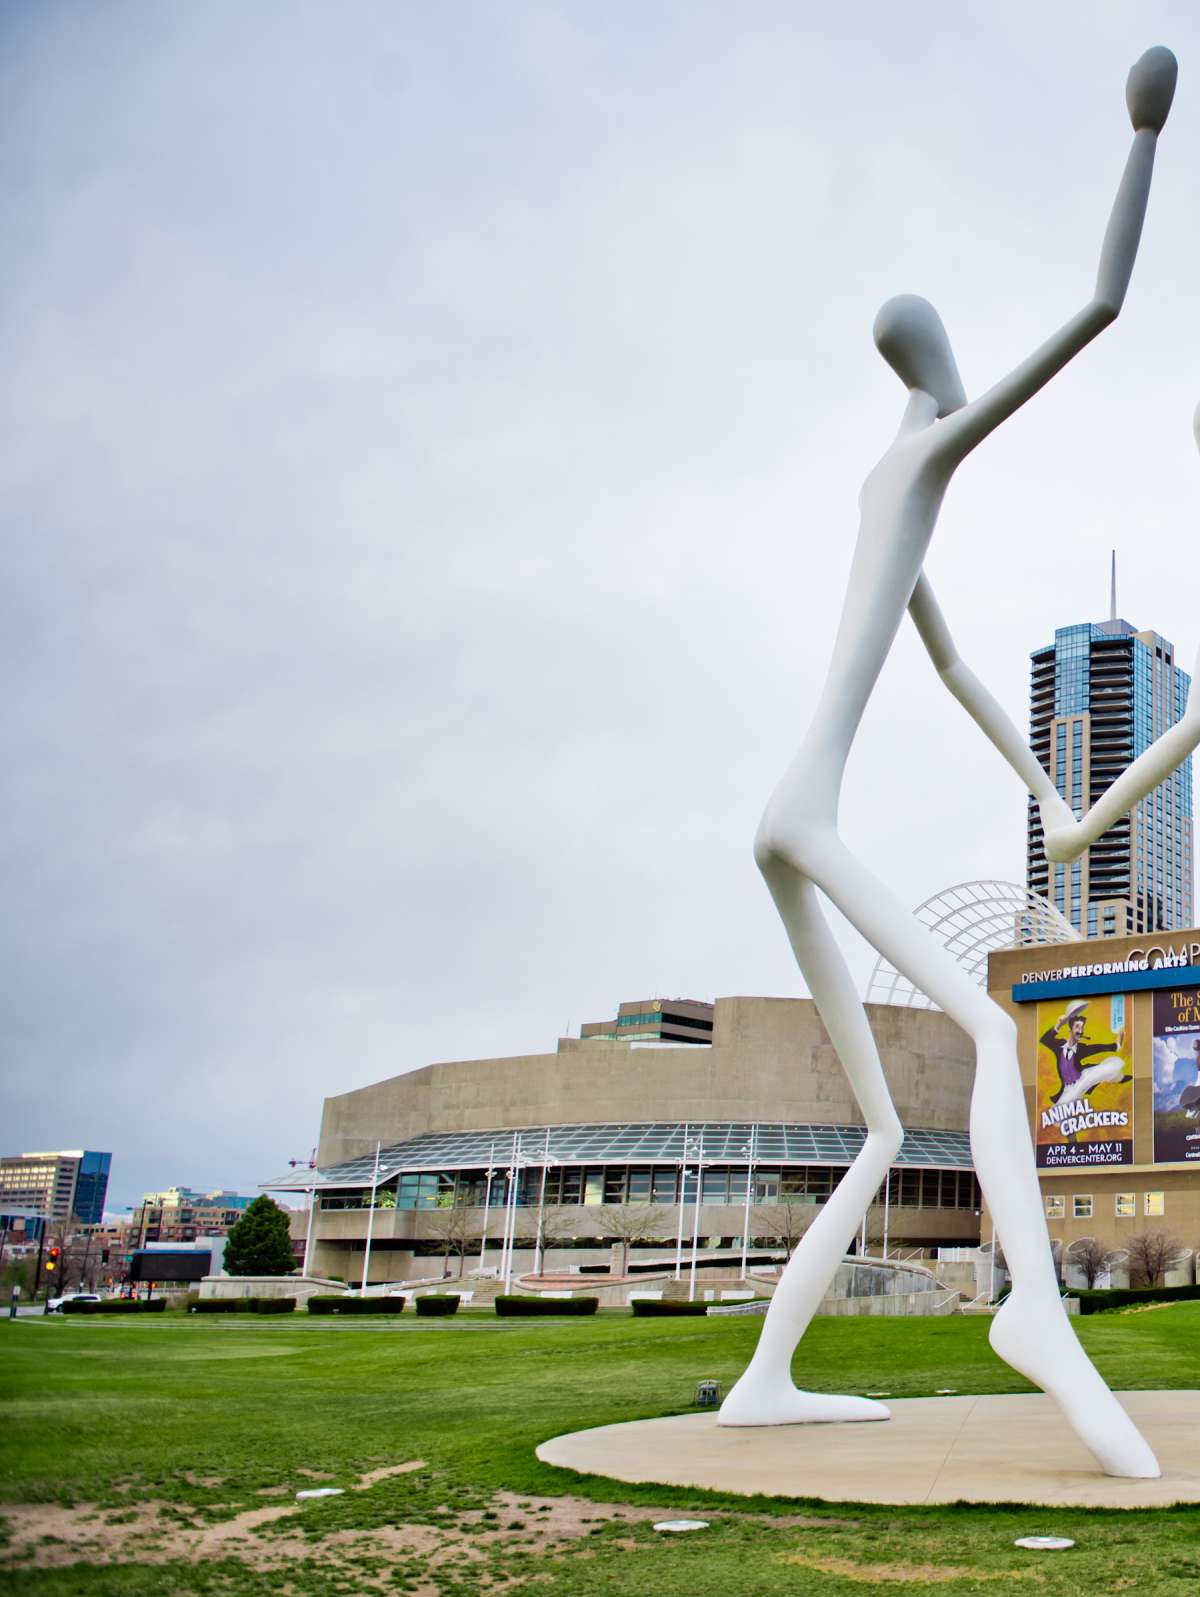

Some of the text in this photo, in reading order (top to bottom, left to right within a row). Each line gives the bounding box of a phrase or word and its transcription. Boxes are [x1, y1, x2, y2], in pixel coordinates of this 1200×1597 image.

[1021, 955, 1188, 984] DENVER PERFORMING ARTS
[1171, 992, 1194, 1008] The
[1178, 1009, 1191, 1023] of
[1041, 1099, 1094, 1128] ANIMAL
[1060, 1111, 1129, 1137] CRACKERS
[1047, 1146, 1066, 1155] APR
[1070, 1146, 1076, 1154] 4
[1088, 1144, 1112, 1153] MAY
[1115, 1143, 1122, 1152] 11
[1046, 1153, 1122, 1165] DENVERCENTER.ORG
